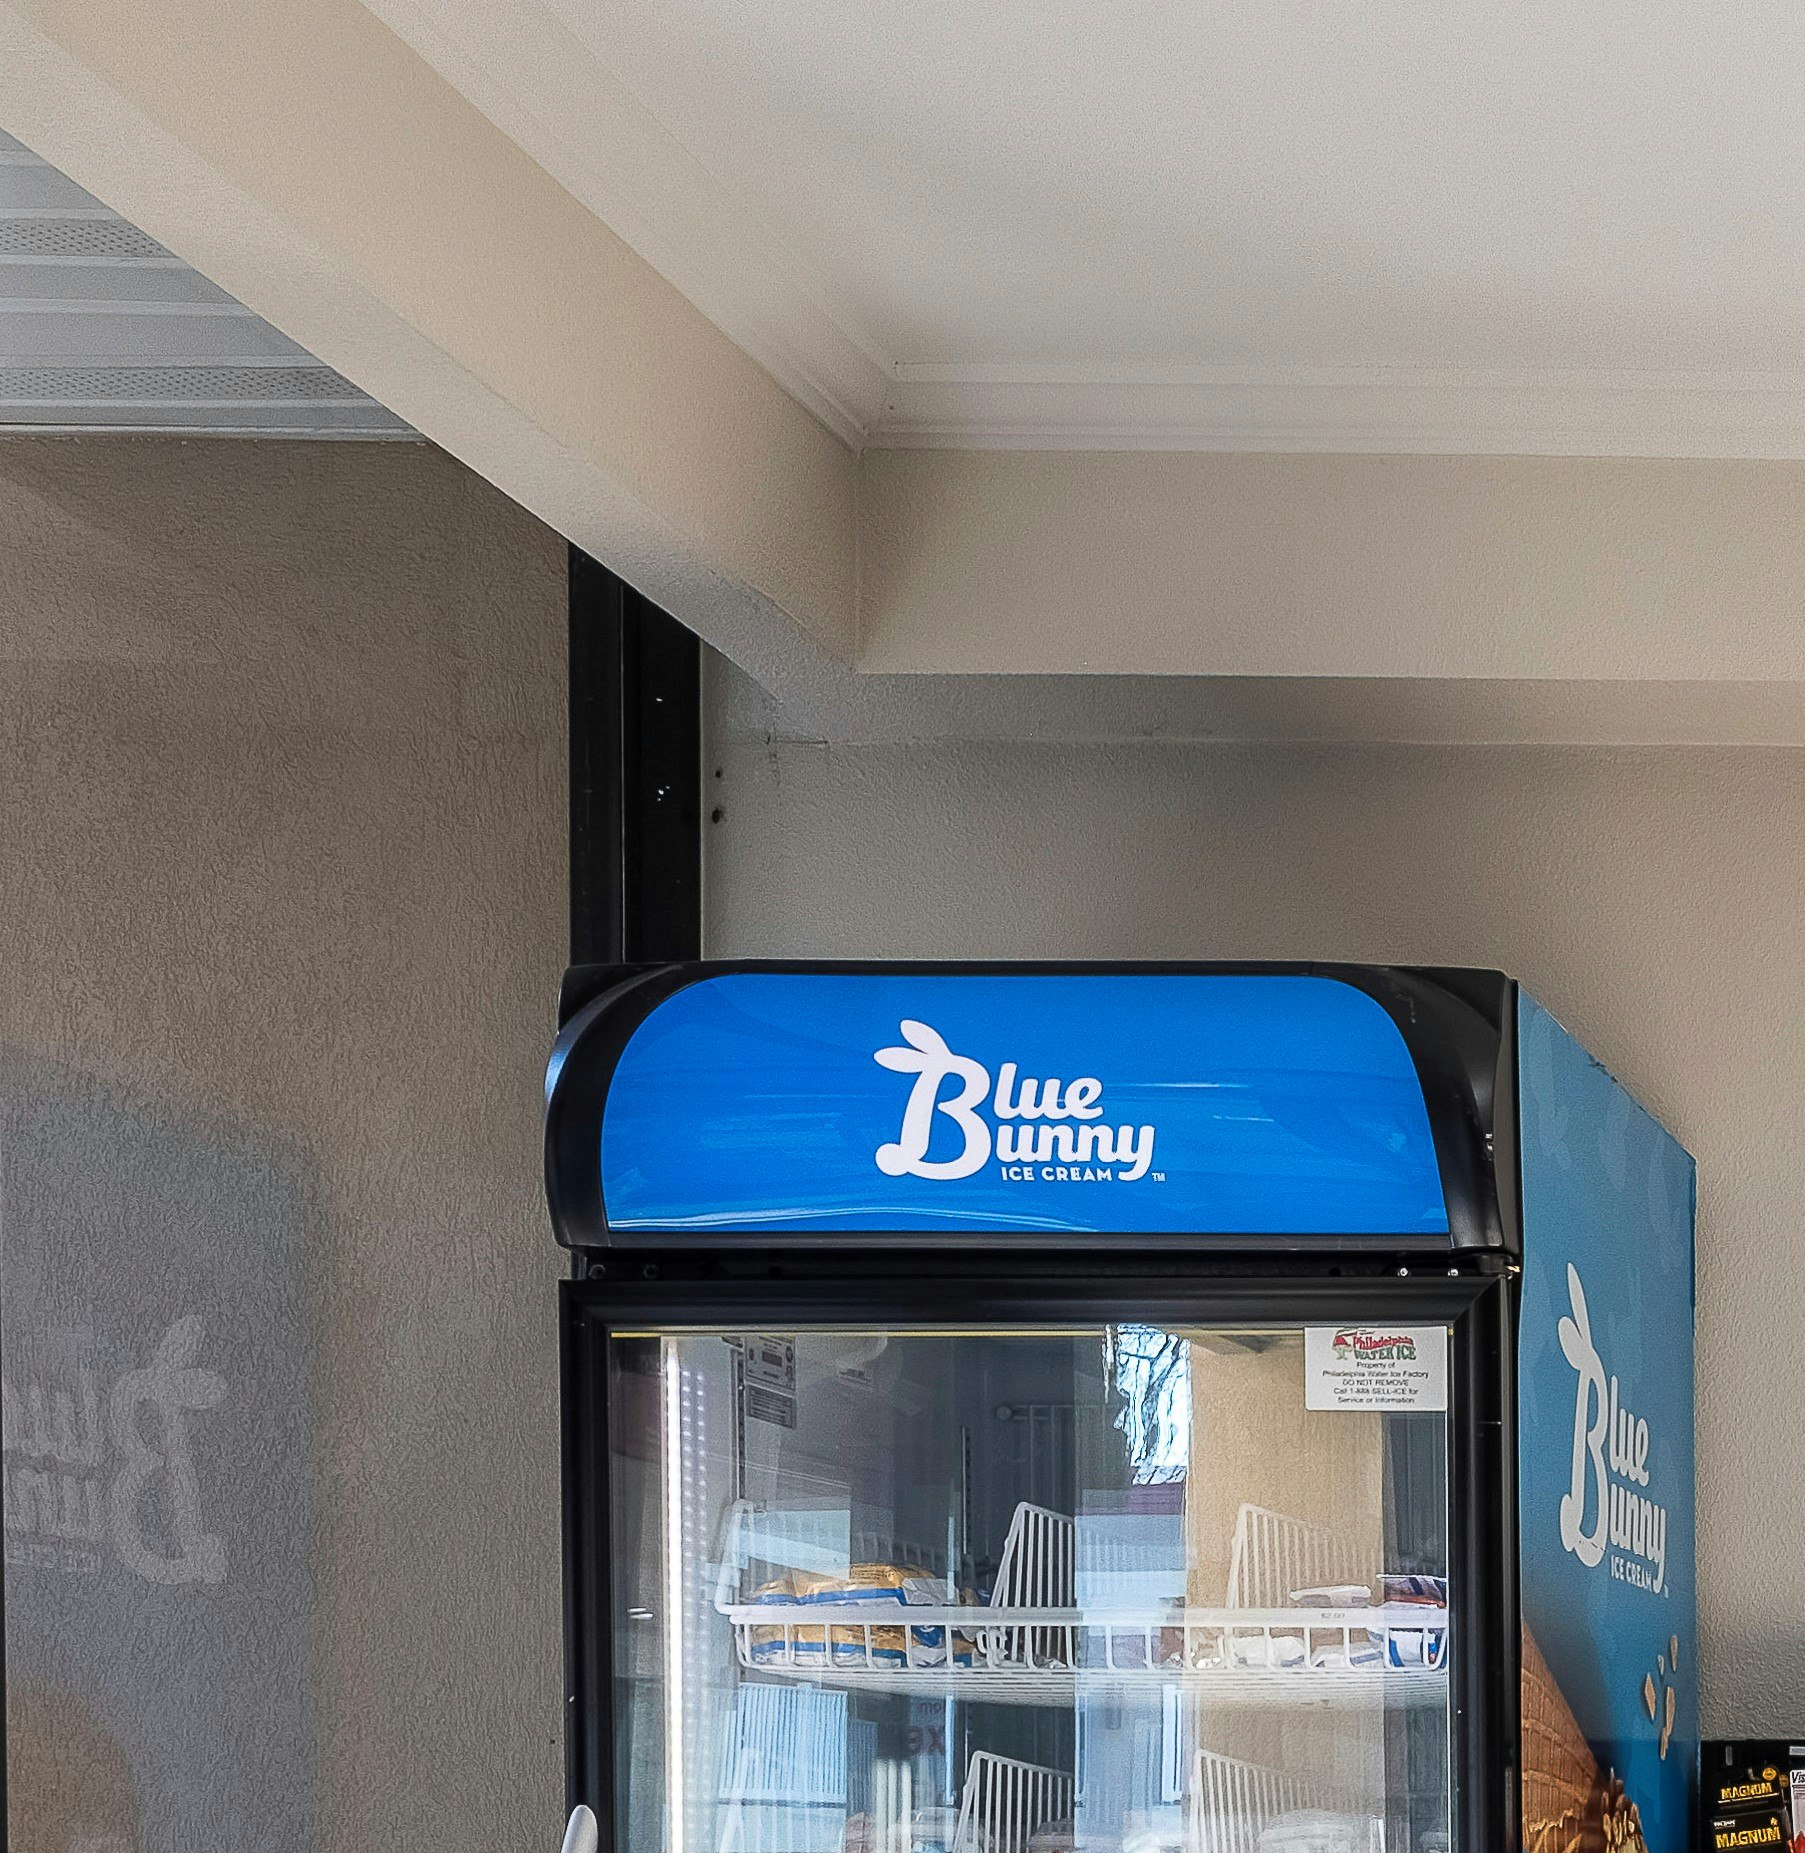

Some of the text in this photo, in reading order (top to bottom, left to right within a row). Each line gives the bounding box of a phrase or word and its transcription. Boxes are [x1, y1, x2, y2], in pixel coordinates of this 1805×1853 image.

[1042, 1167, 1112, 1182] CREAM
[1354, 1336, 1413, 1349] Philadelphia
[1353, 1346, 1416, 1360] WATER ICE
[1716, 1827, 1780, 1848] MAGNUM
